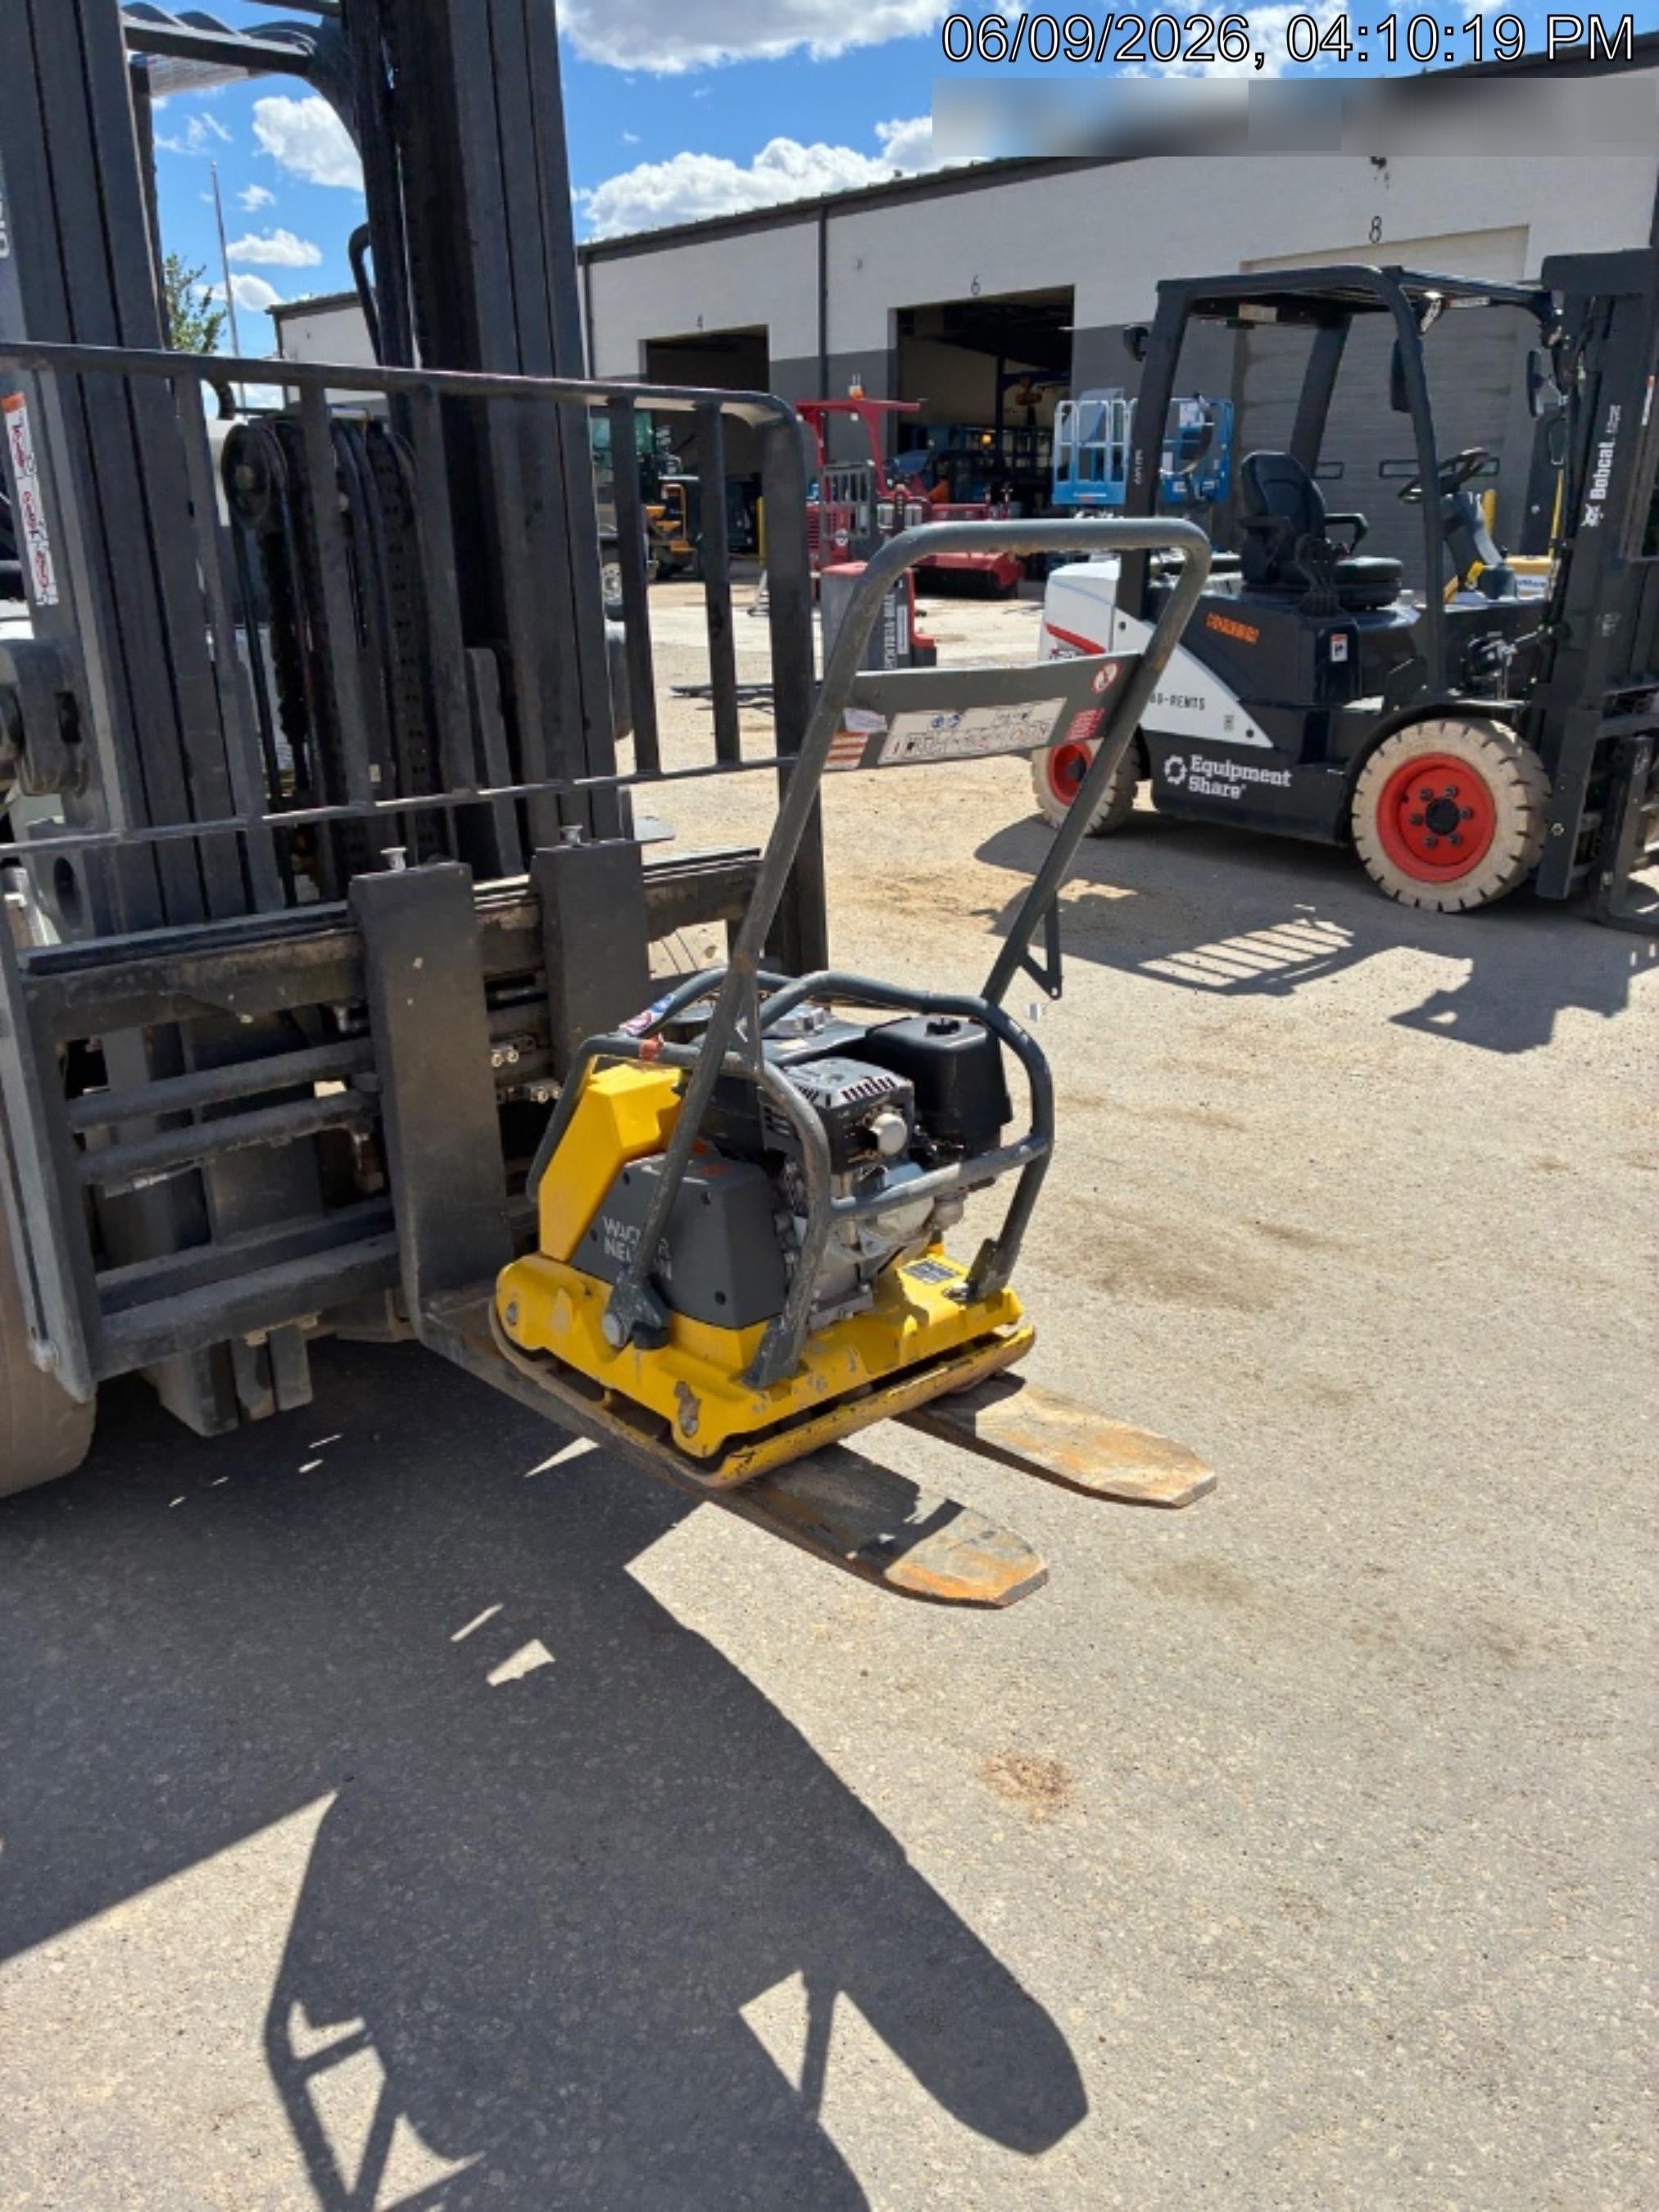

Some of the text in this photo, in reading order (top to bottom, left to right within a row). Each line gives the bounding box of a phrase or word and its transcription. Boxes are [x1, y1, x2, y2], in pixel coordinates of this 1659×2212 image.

[1369, 215, 1382, 243] 8
[970, 274, 981, 296] 6
[1589, 441, 1616, 501] Bobcat
[1190, 754, 1292, 787] Equipment
[1188, 775, 1241, 800] Share
